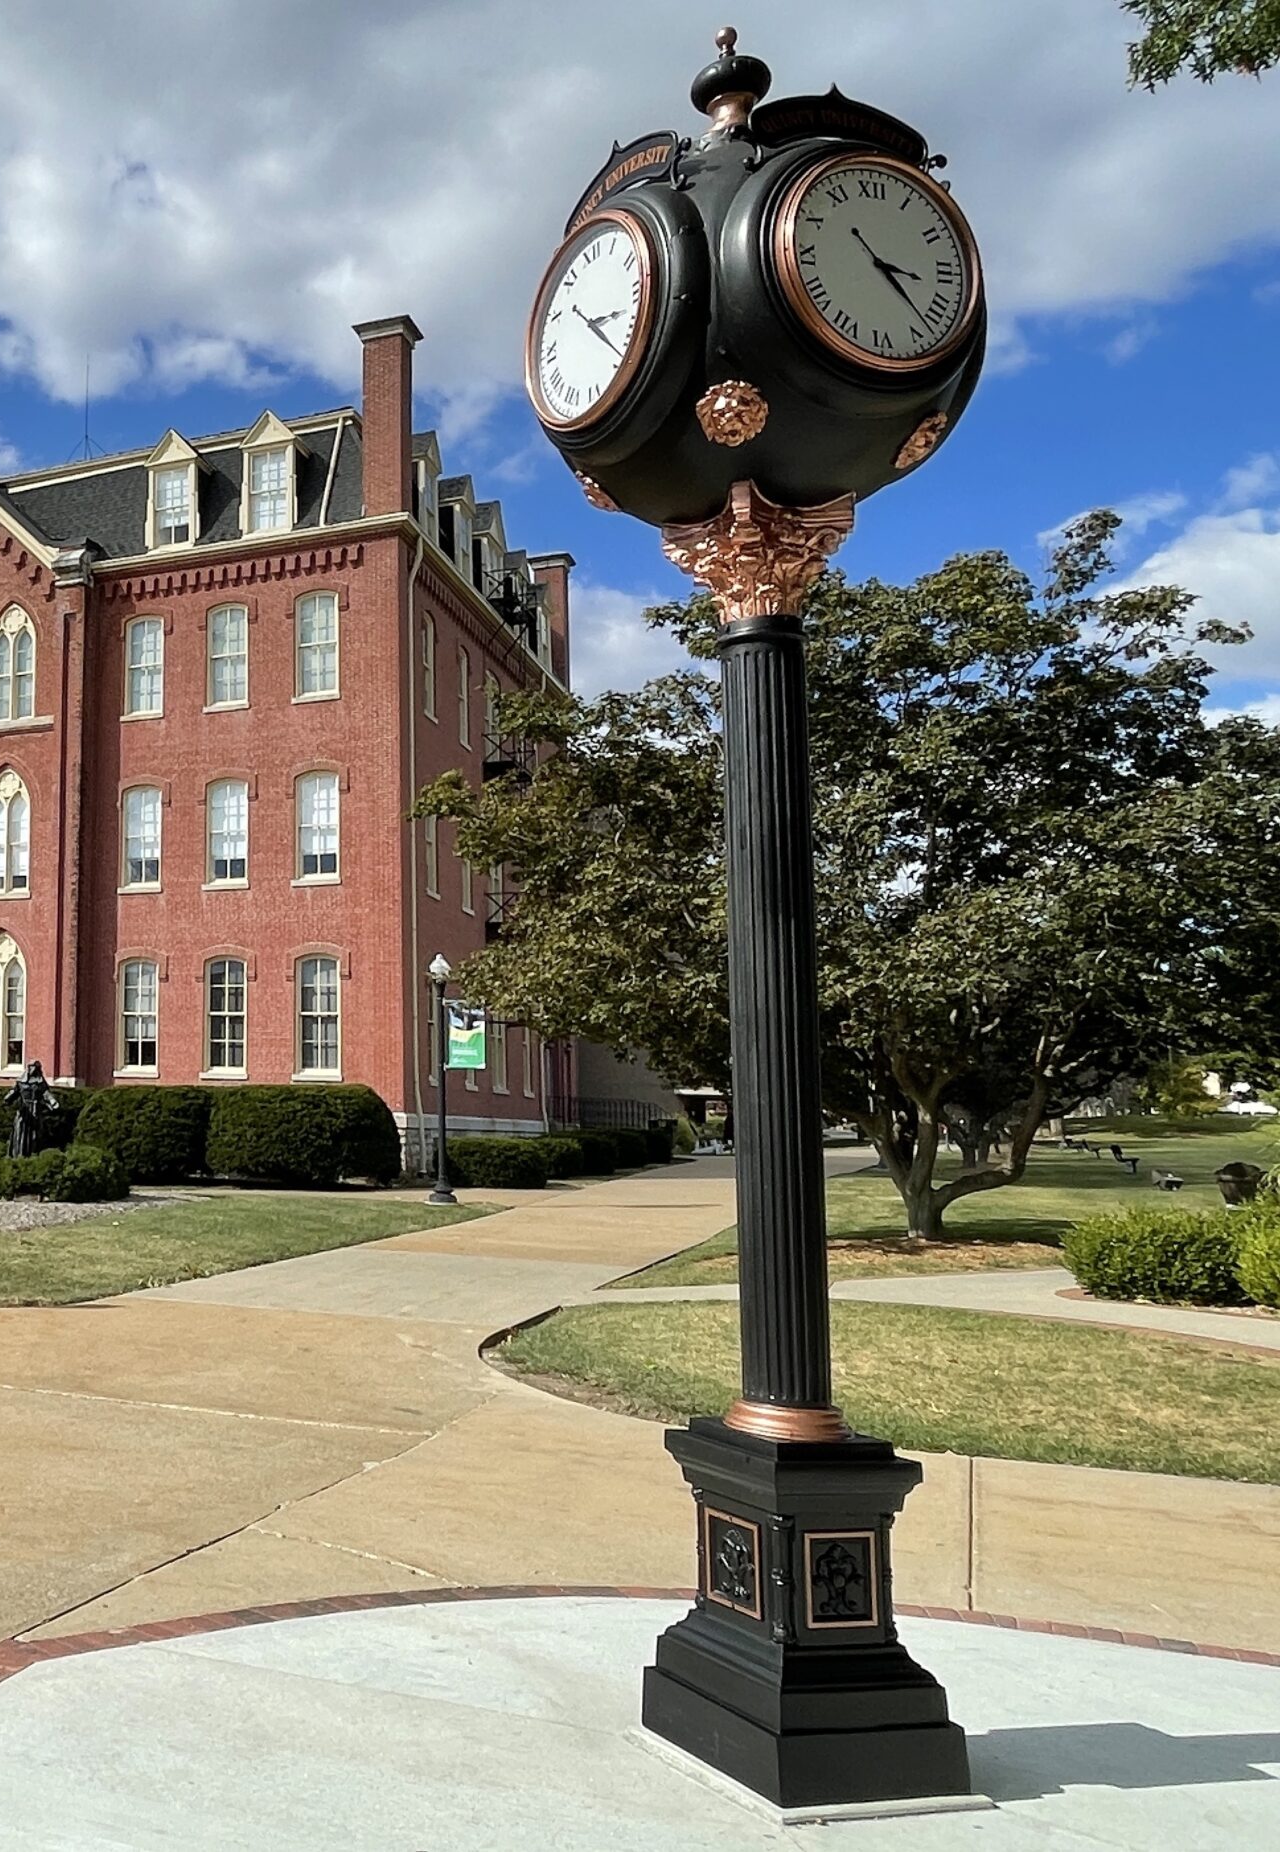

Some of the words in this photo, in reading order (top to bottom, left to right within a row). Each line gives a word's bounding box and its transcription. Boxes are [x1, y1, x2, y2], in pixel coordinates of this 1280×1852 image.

[605, 145, 672, 191] UNIVERSITY
[826, 184, 849, 207] XI
[858, 180, 886, 200] XII
[899, 197, 911, 210] I
[805, 210, 824, 231] X
[922, 227, 940, 245] II
[799, 243, 816, 267] IX
[936, 261, 953, 285] III
[806, 277, 832, 312] VIII
[925, 293, 950, 325] IIII
[833, 310, 859, 340] VII
[909, 325, 924, 343] V
[872, 329, 893, 349] VI
